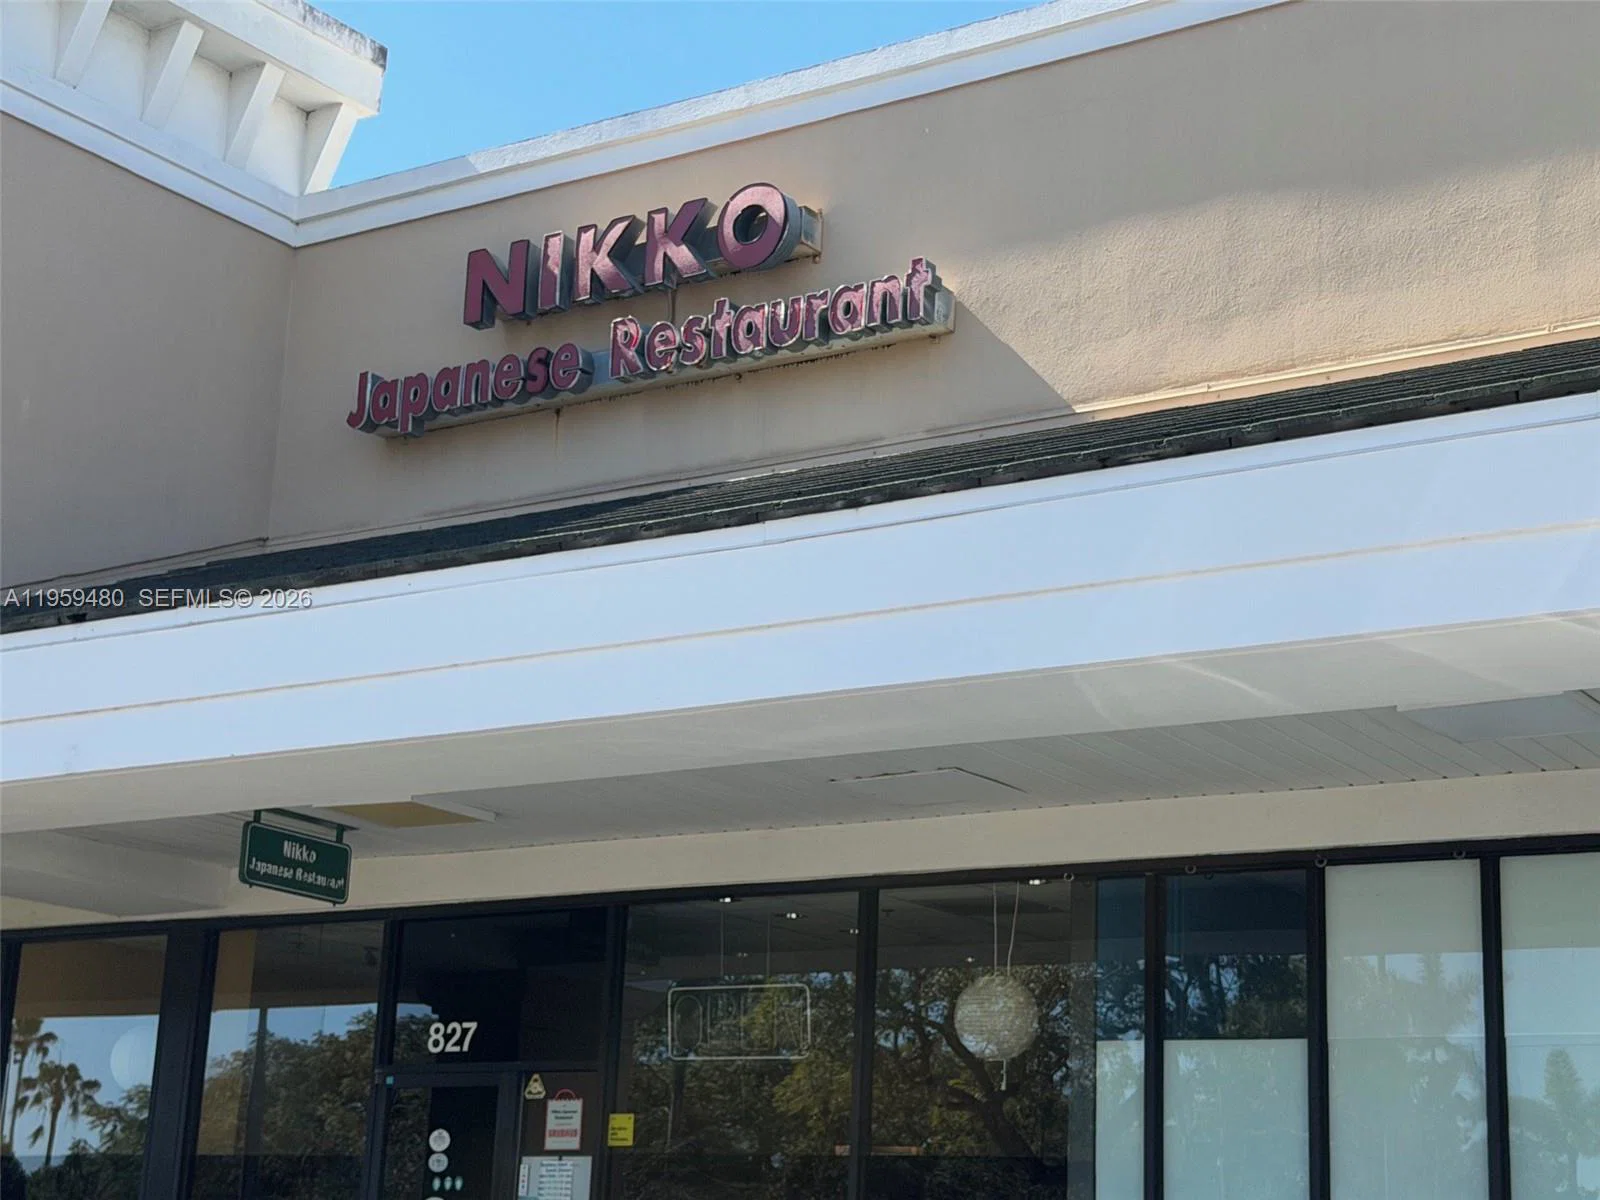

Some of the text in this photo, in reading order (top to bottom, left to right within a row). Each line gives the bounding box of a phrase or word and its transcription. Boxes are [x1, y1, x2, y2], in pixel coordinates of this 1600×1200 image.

[463, 182, 790, 328] NIKKO
[347, 256, 935, 433] Japanese Restaurant
[283, 840, 317, 863] Nikko
[249, 857, 293, 879] Japanese
[427, 1021, 478, 1053] 827
